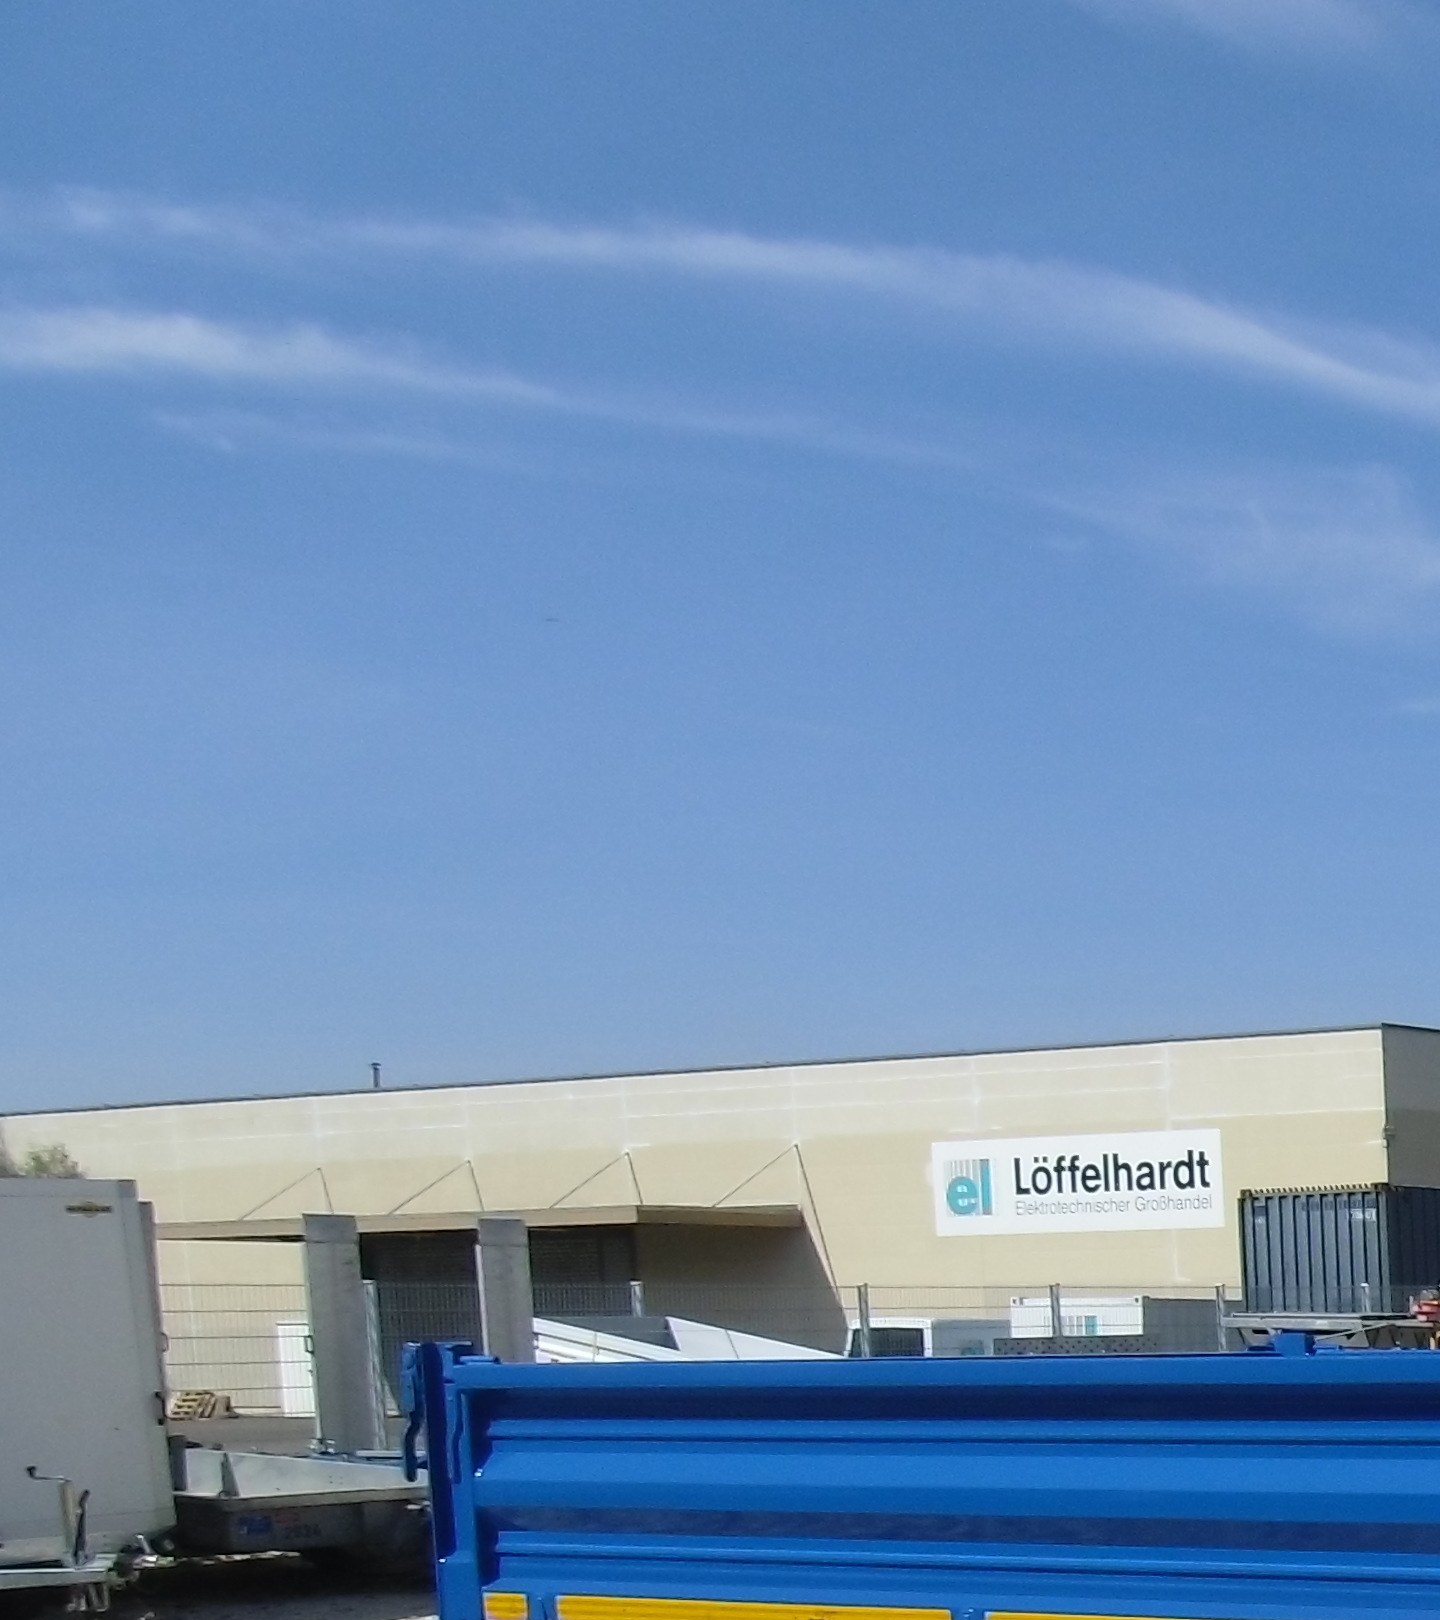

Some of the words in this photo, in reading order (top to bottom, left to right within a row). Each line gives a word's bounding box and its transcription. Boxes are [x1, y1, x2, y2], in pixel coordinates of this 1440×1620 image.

[1014, 1150, 1210, 1195] Löffelhardt
[1016, 1197, 1129, 1215] Elektrotechnischer
[1135, 1194, 1212, 1211] Großhandel
